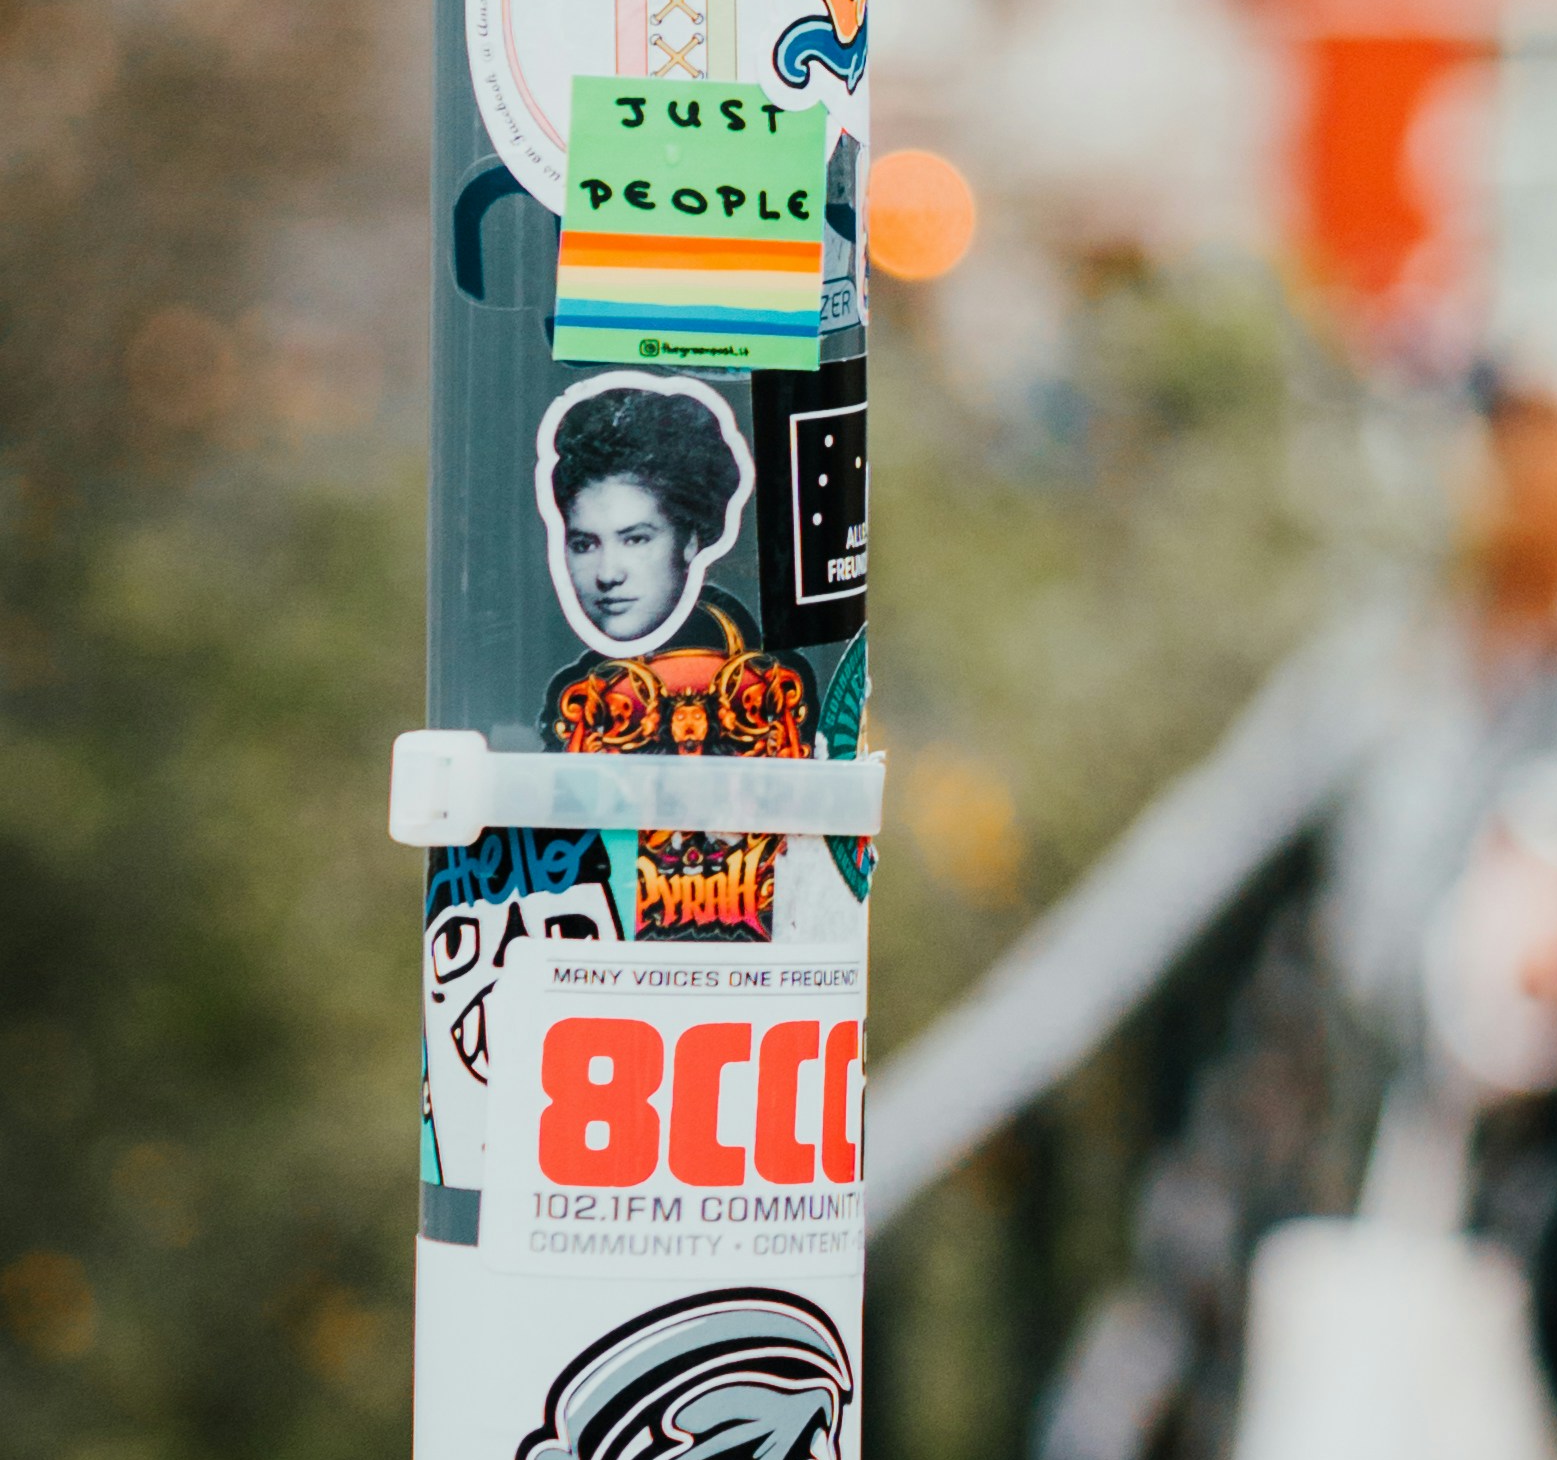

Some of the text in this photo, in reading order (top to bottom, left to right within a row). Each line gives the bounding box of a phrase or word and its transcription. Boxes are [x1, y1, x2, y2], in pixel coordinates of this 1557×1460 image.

[616, 97, 785, 133] JUST
[579, 178, 811, 221] PEOPLE
[553, 967, 622, 986] MANY
[633, 970, 719, 988] VOICES
[729, 970, 772, 988] ONE
[538, 1017, 858, 1187] 8CCC
[532, 1192, 682, 1222] 102.1FM
[529, 1230, 723, 1256] COMMUNITY
[753, 1230, 849, 1256] CONTENT
